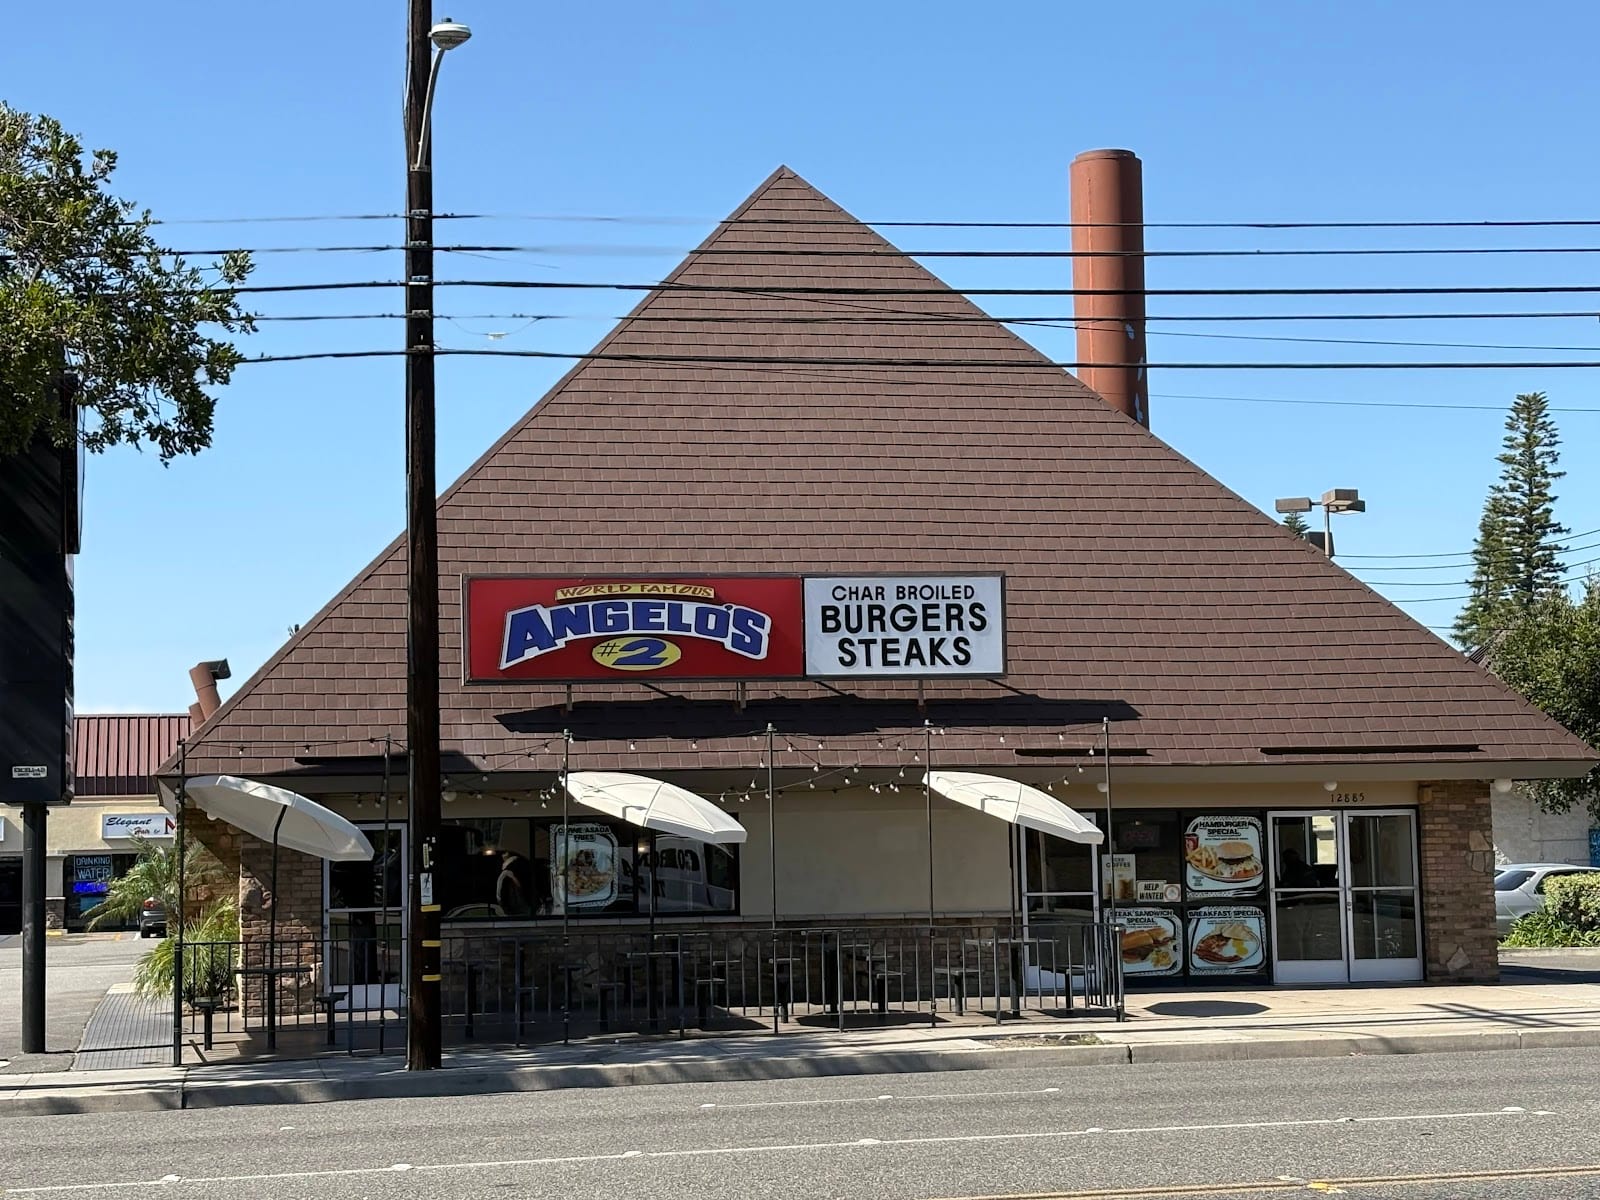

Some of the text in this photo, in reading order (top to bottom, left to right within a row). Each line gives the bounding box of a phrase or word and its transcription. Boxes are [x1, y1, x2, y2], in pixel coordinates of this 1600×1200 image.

[559, 583, 714, 599] WORLD FAMOUS
[831, 584, 975, 601] CHAR BROILED
[820, 602, 988, 634] BURGERS
[505, 601, 767, 664] ANGELO'S
[596, 638, 670, 666] #2
[837, 636, 972, 667] STEAKS
[105, 816, 152, 828] Elegant
[76, 867, 110, 880] WATER
[1143, 883, 1160, 891] HELP
[1139, 892, 1164, 900] WANTED
